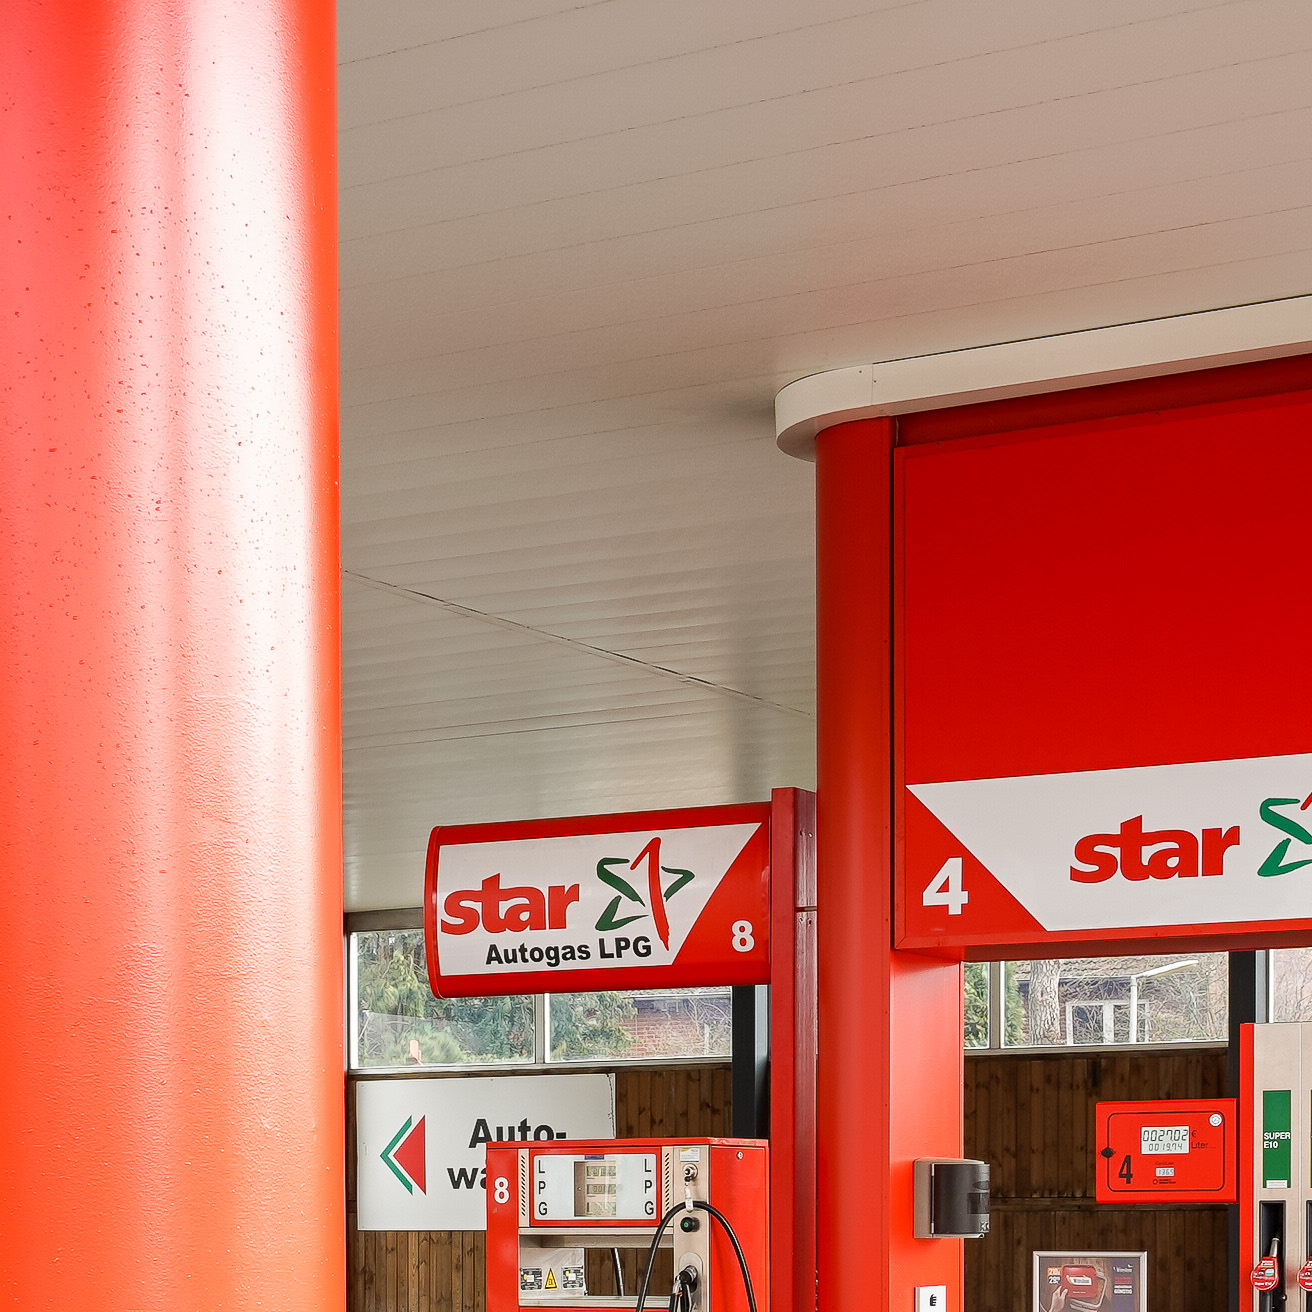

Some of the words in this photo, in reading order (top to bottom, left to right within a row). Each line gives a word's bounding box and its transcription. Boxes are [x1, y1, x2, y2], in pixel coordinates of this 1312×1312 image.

[1069, 815, 1240, 884] star
[922, 857, 969, 915] 4
[440, 873, 580, 936] star
[485, 942, 591, 967] Autogas
[599, 936, 652, 960] LPG
[731, 920, 755, 953] 8
[469, 1118, 566, 1148] Auto-
[1263, 1131, 1291, 1141] SUPER
[1263, 1141, 1278, 1149] E10
[1118, 1155, 1133, 1184] 4
[494, 1177, 510, 1204] 8
